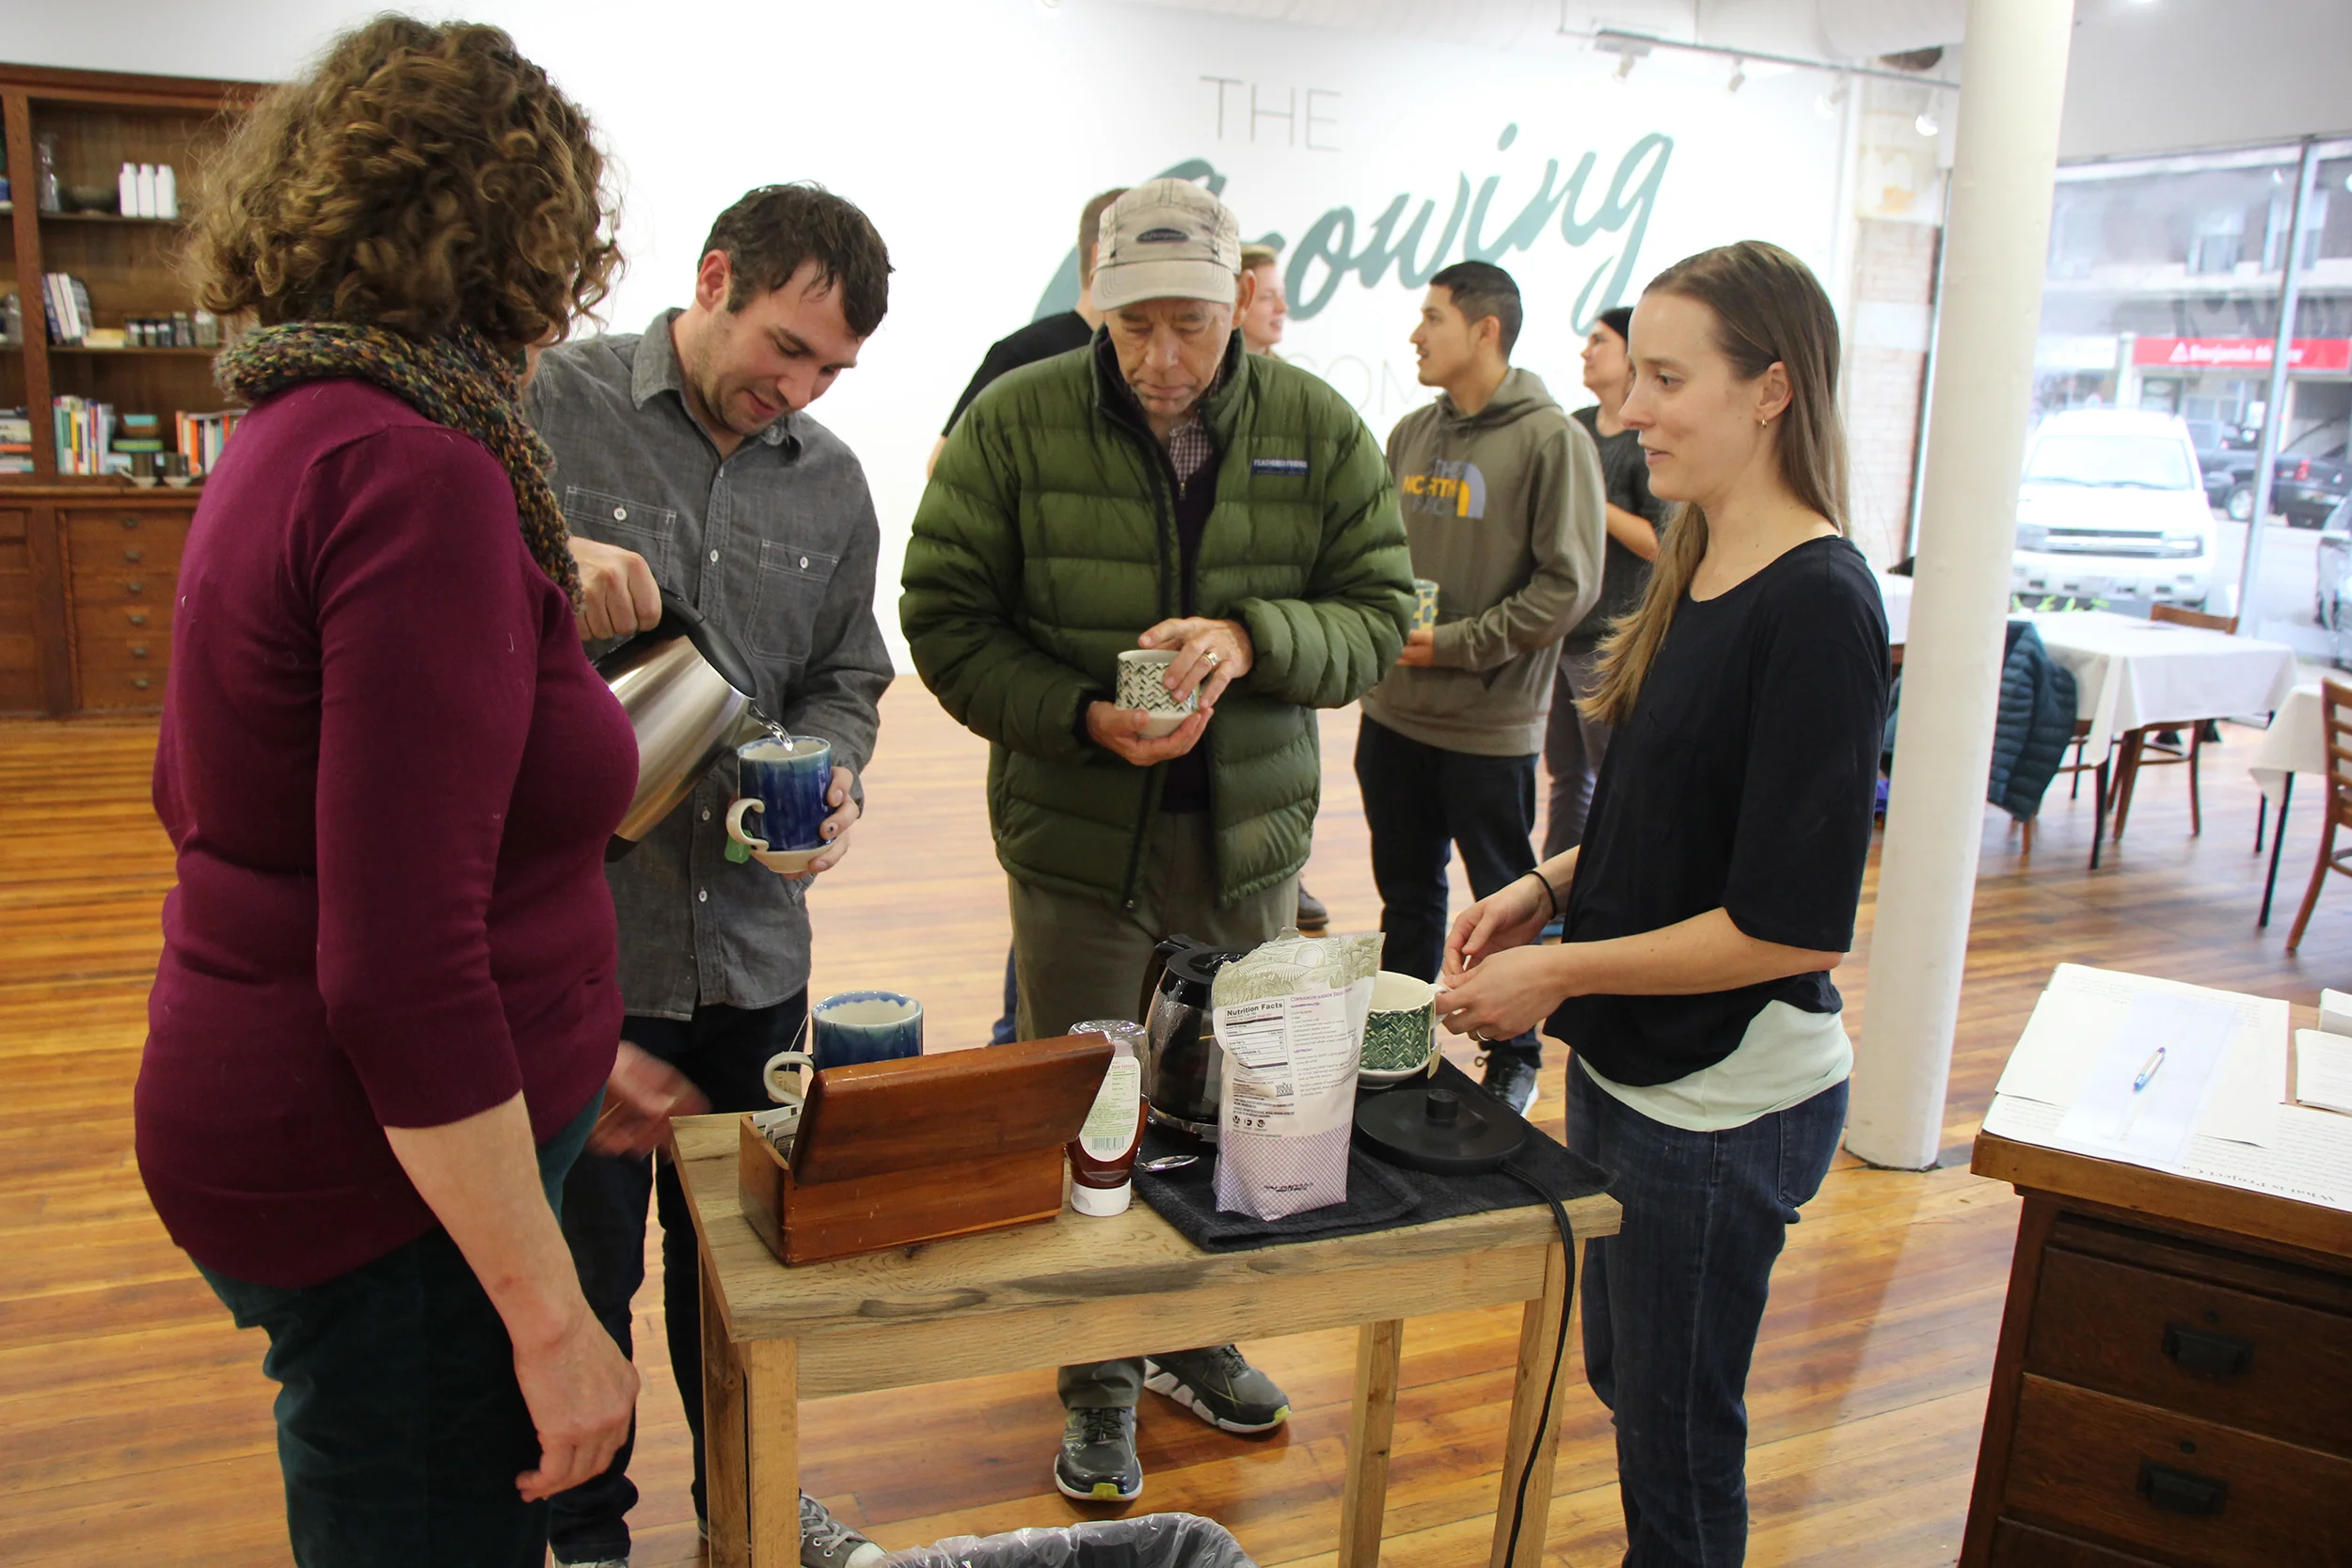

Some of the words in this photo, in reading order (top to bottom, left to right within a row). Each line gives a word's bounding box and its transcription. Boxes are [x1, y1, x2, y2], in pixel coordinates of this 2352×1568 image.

[1200, 75, 1343, 152] THE
[1032, 122, 1675, 337] owing
[1227, 1006, 1260, 1017] Nutrition
[1261, 1002, 1283, 1011] Facts
[2209, 1170, 2265, 1188] Project
[2272, 1183, 2284, 1192] is
[2290, 1187, 2336, 1203] What
